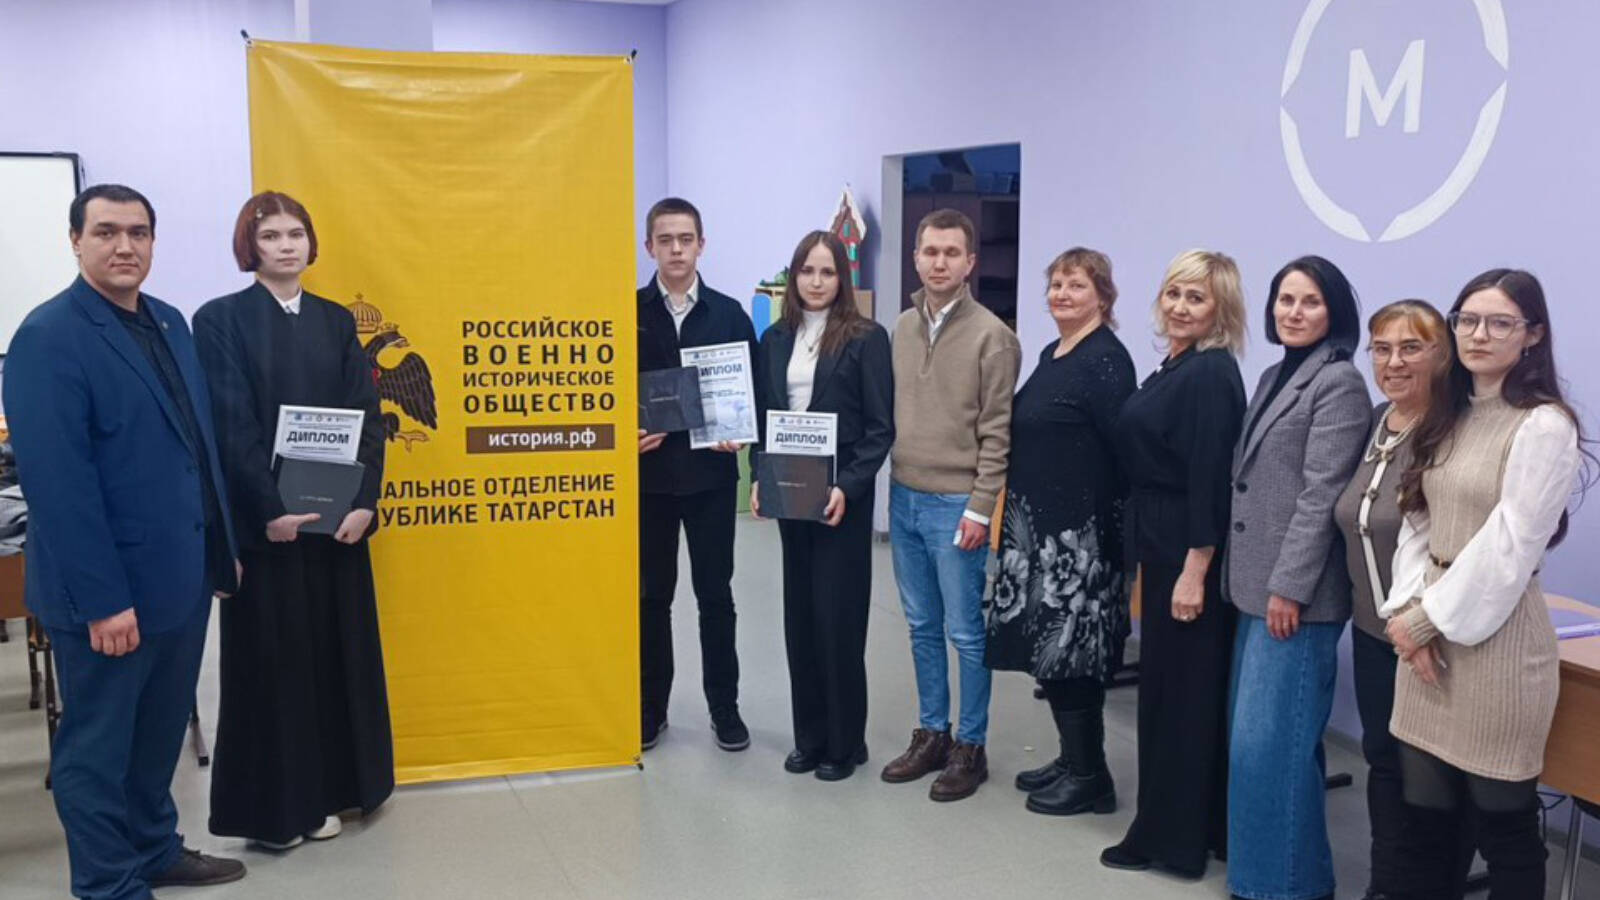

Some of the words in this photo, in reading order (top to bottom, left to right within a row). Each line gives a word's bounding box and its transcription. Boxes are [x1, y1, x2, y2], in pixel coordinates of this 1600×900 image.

[462, 316, 613, 338] РОССИЙСКОЕ
[463, 344, 614, 366] ВОЕННО
[463, 370, 614, 387] ИСТОРИЧЕСКОЕ
[700, 364, 742, 376] ИПЛОМ
[464, 392, 615, 416] ОБЩЕСТВО
[287, 431, 349, 444] ДИПЛОМ
[488, 428, 596, 449] история.рф
[775, 432, 827, 444] ДИПЛОМ
[383, 479, 476, 499] АЛЬНОЕ
[484, 474, 615, 497] ОТДЕЛЕНИЕ
[380, 503, 478, 527] УБЛИКЕ
[487, 498, 614, 522] ТАТАРСТАН
